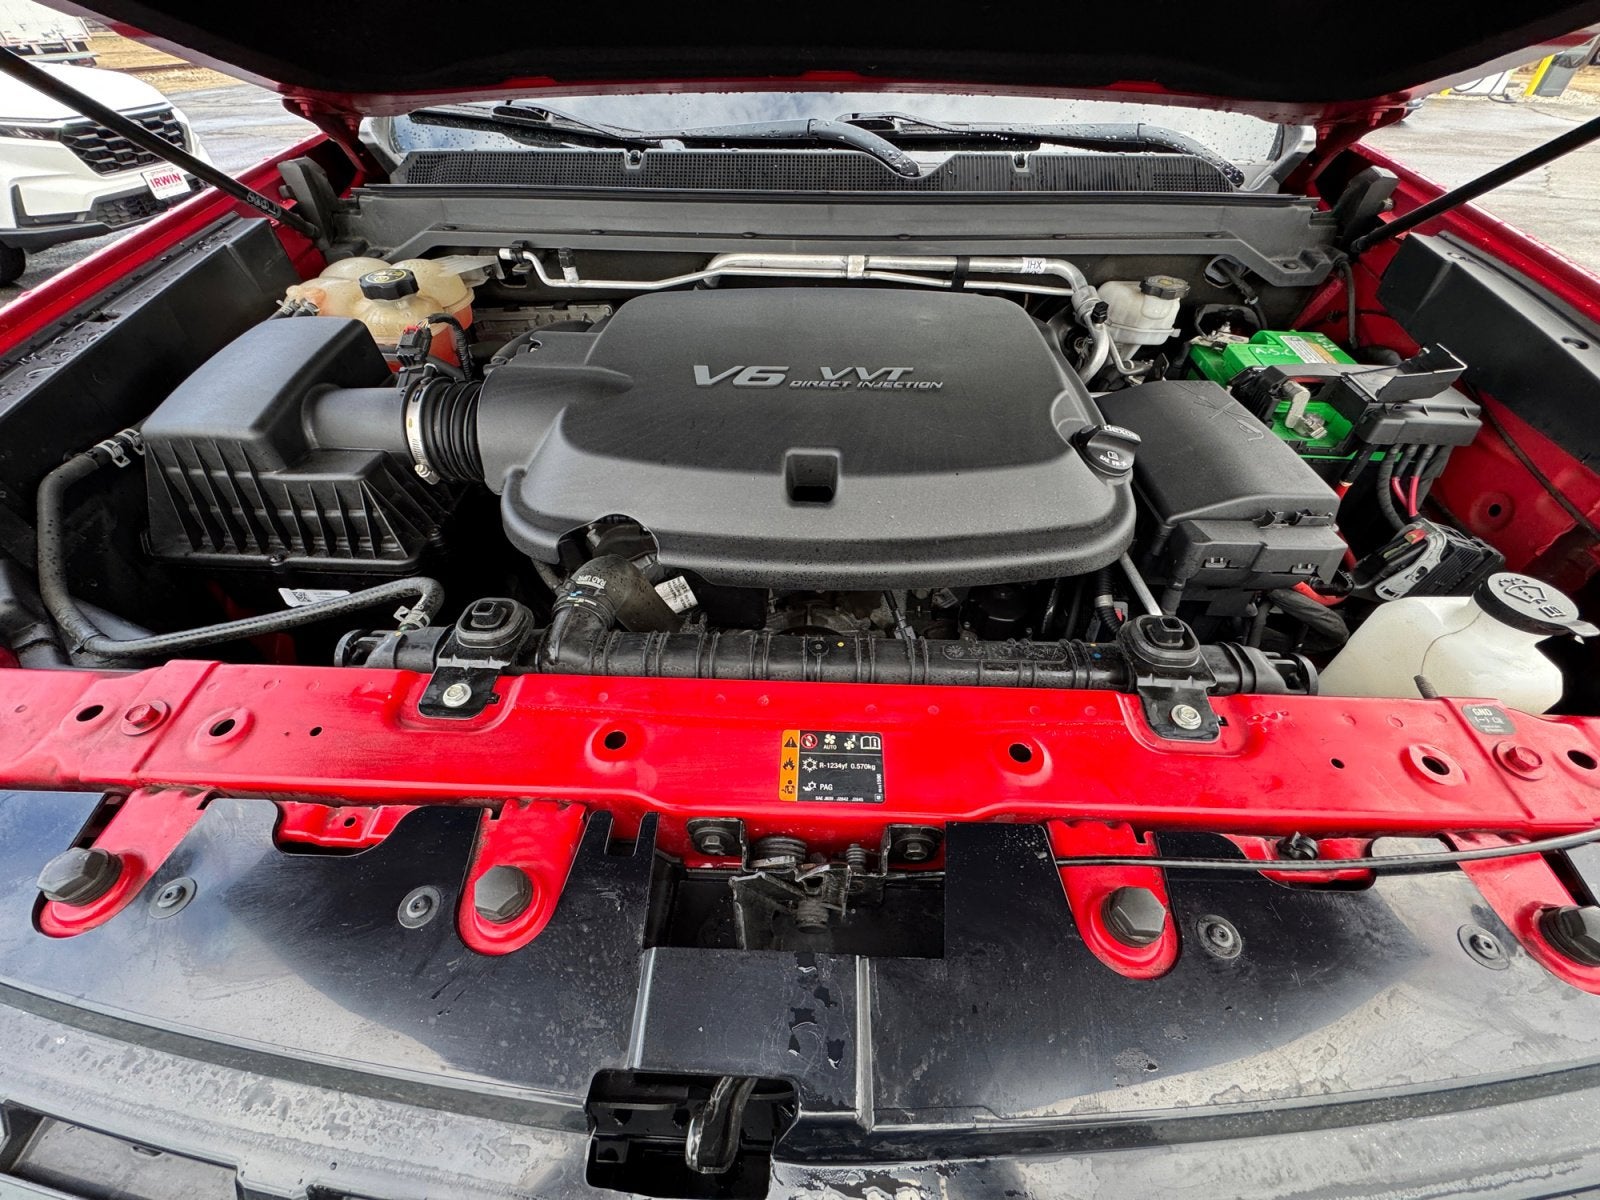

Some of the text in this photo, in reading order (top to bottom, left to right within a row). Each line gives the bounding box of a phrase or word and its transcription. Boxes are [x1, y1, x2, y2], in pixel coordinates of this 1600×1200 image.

[150, 172, 182, 188] IRWIN
[693, 364, 915, 388] V6 VVT
[789, 379, 945, 390] DIRECT INJECTION
[819, 783, 833, 791] PAG
